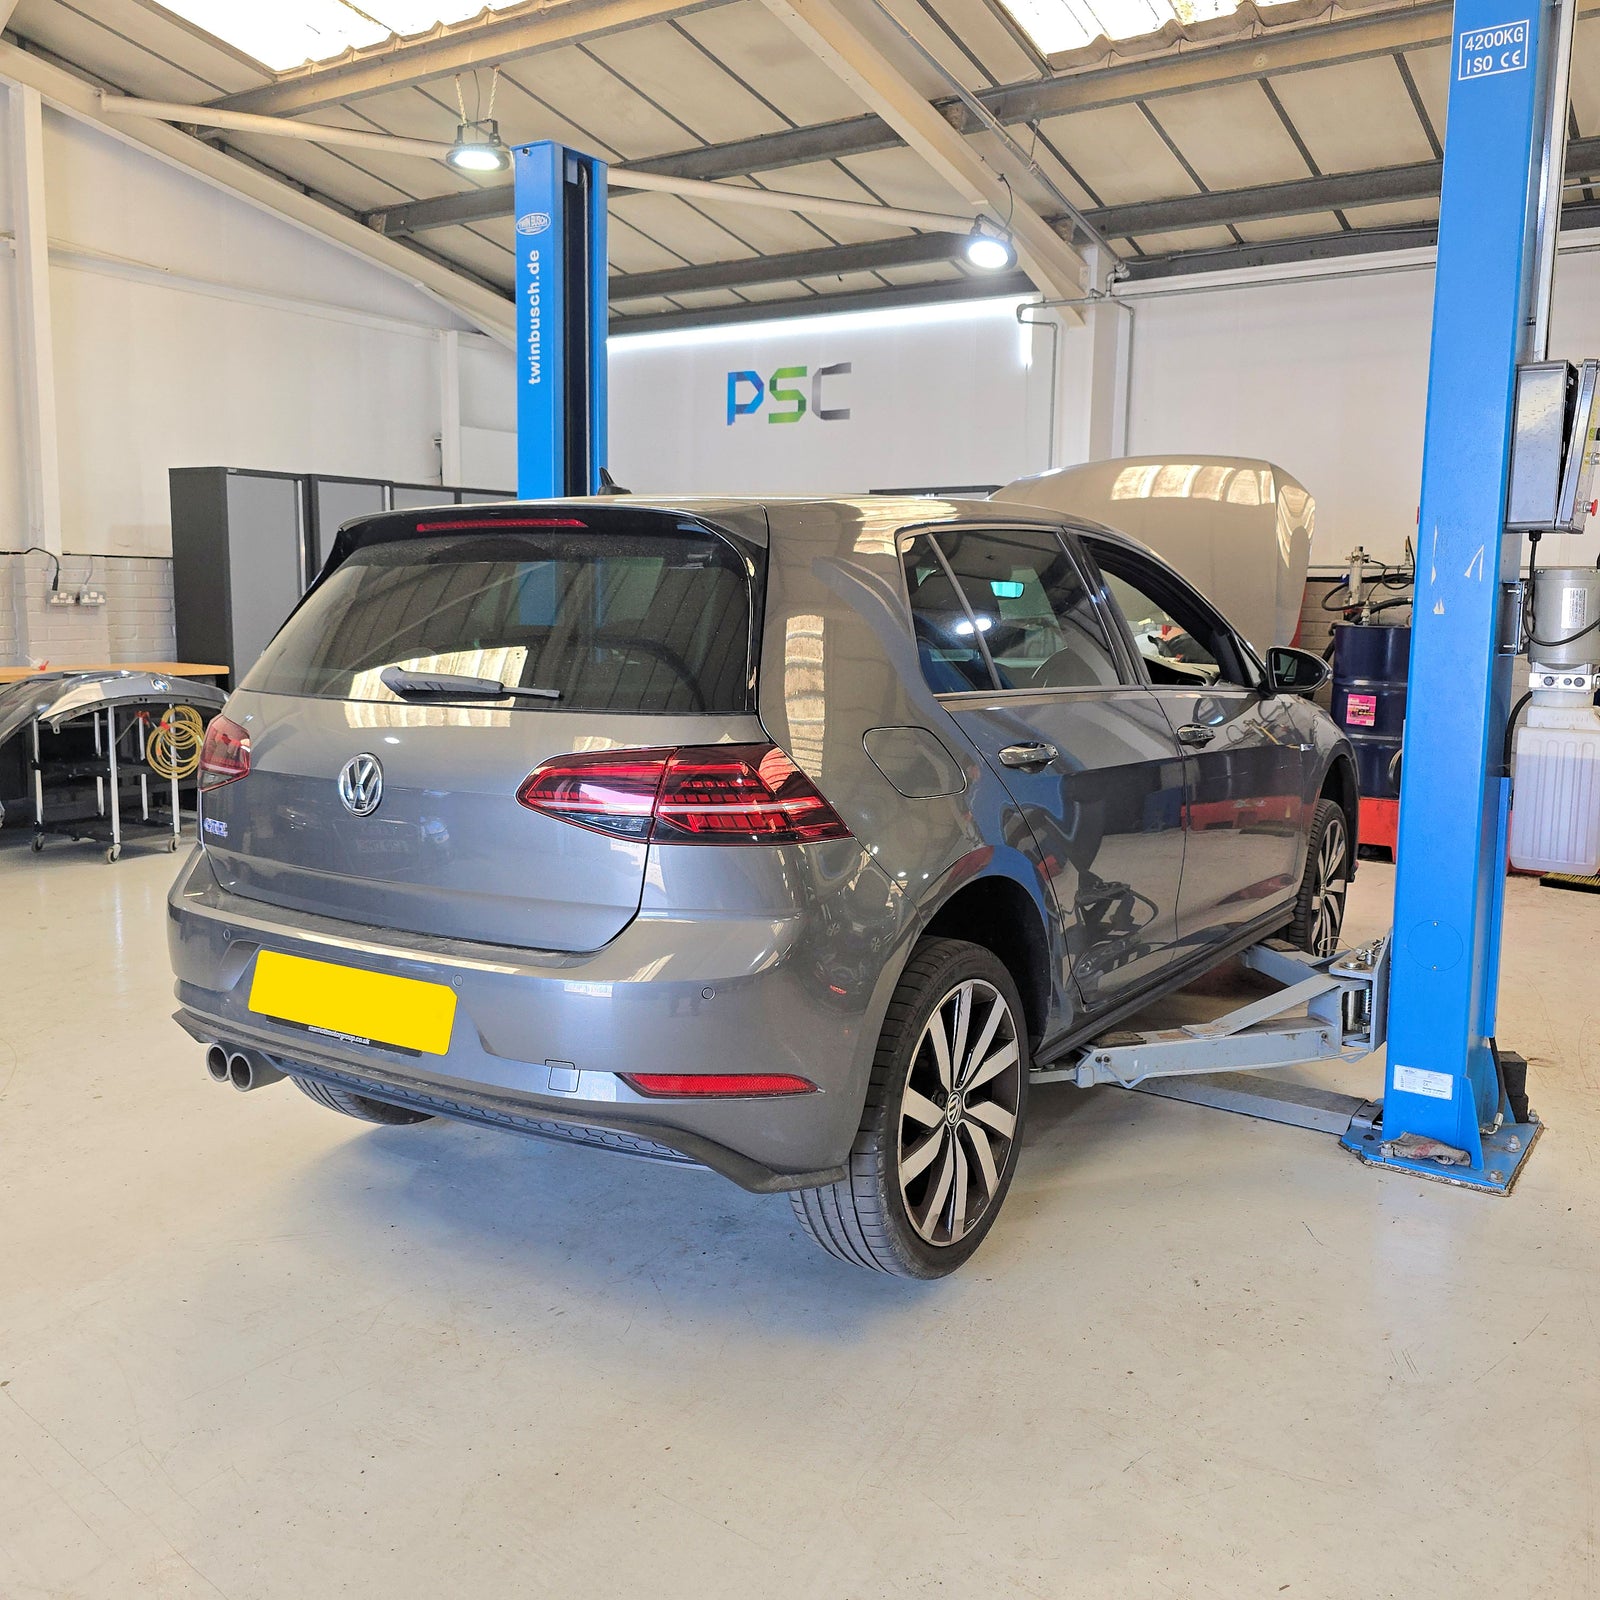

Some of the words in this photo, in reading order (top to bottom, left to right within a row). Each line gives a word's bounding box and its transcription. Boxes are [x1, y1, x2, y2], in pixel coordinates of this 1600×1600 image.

[1464, 26, 1524, 52] 4200KG
[1466, 55, 1493, 75] ISO
[527, 249, 541, 385] twinbusch.de
[727, 362, 851, 426] PSC
